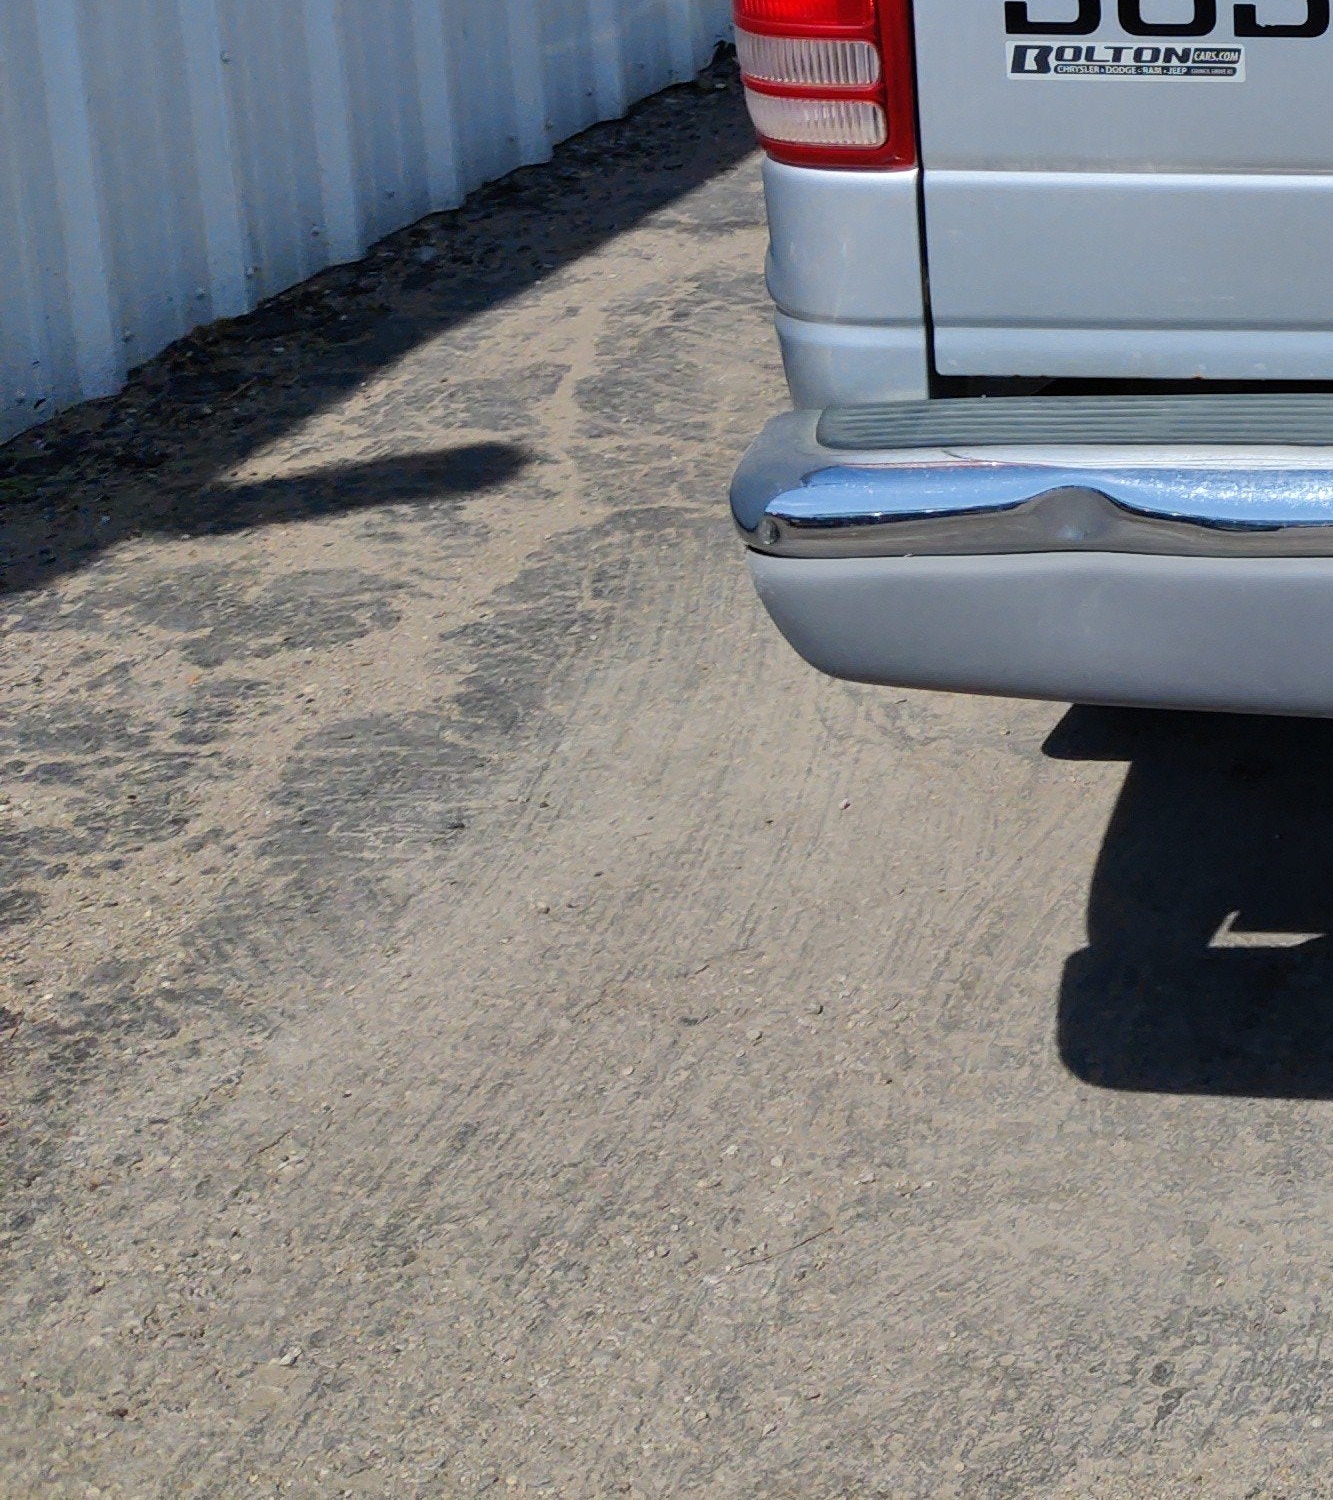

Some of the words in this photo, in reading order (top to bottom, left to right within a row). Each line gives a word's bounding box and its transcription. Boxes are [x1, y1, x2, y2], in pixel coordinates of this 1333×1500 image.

[1011, 45, 1192, 74] BOLTON
[1194, 50, 1239, 62] CARS.COM
[1057, 65, 1100, 74] CHRYSLER
[1106, 66, 1137, 75] DODGE
[1142, 66, 1163, 75] RAM
[1168, 67, 1188, 75] JEEP
